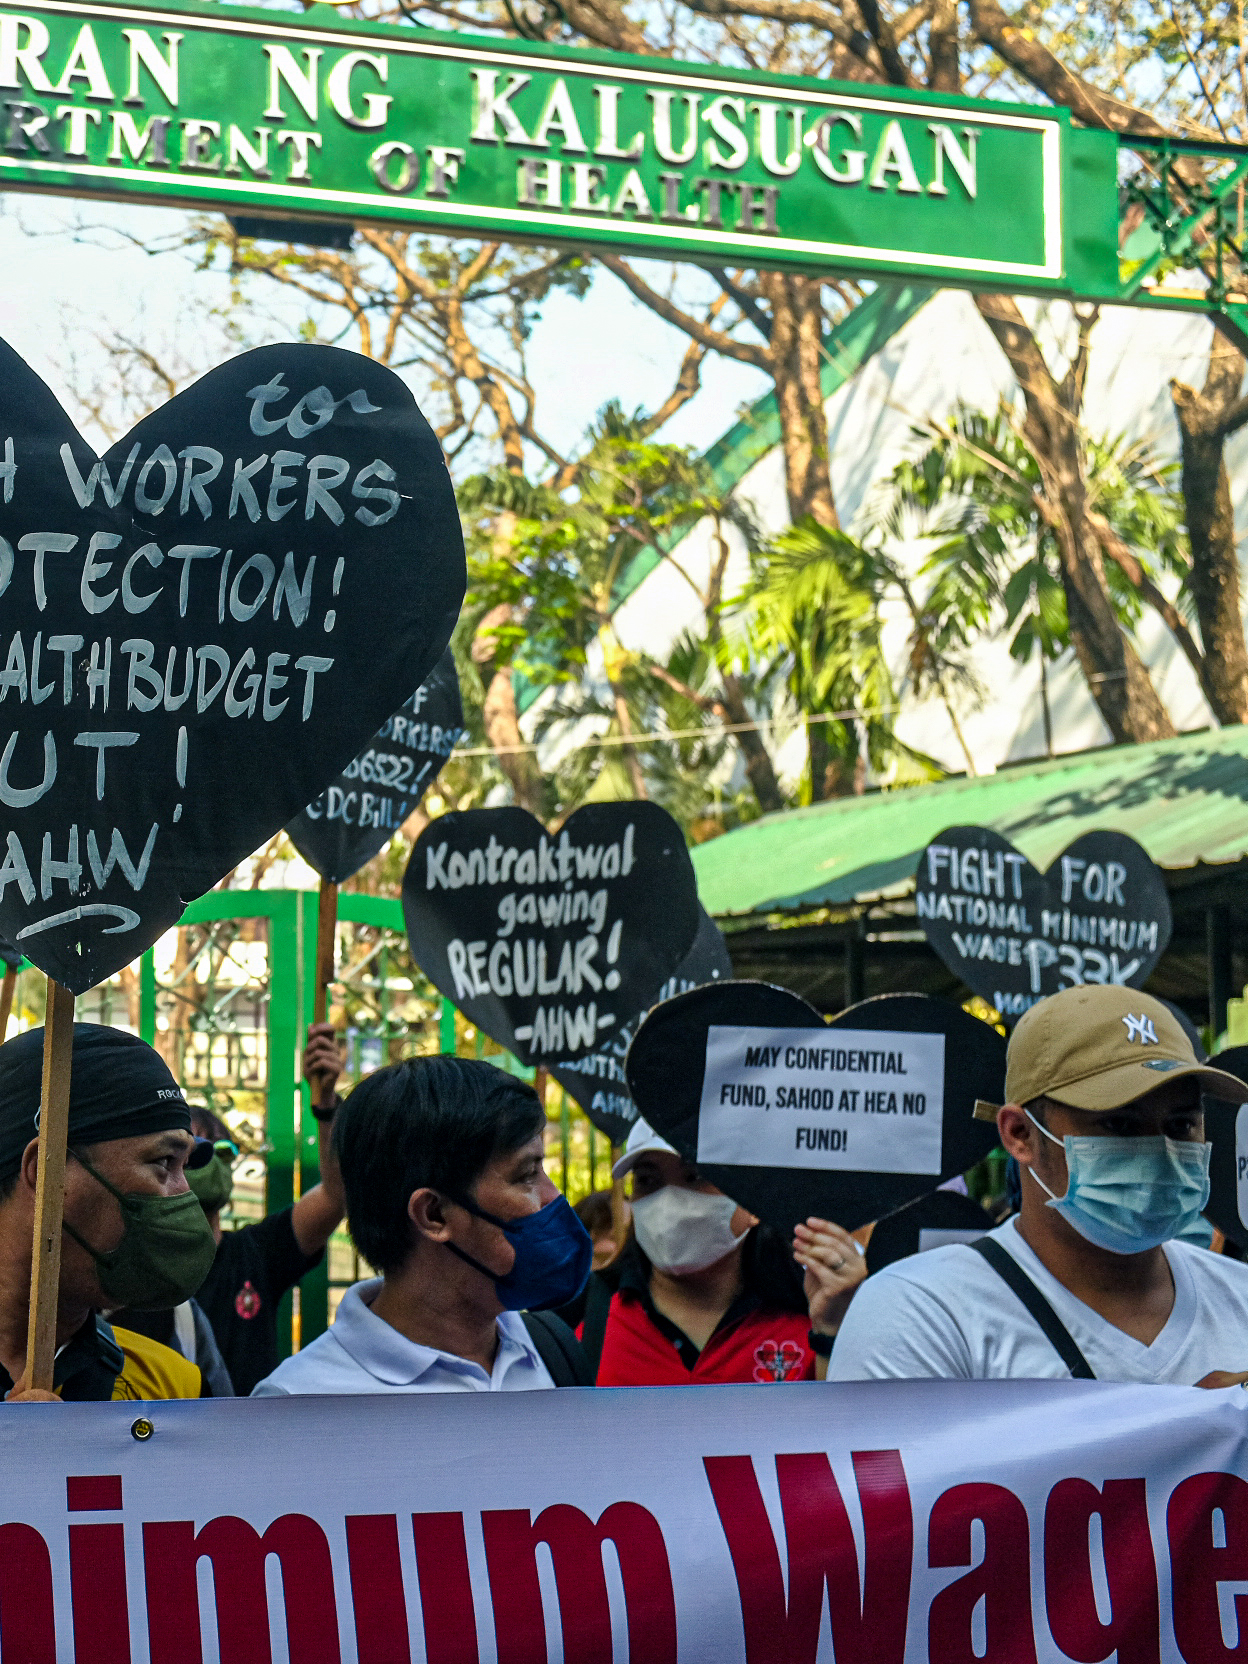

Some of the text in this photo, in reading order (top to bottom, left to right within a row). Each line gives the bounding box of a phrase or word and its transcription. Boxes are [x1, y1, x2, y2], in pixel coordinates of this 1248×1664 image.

[262, 43, 393, 132] NG
[469, 67, 981, 199] KALUSUGAN
[371, 141, 466, 197] OF
[517, 158, 780, 234] HEALTH
[59, 442, 403, 527] WORKERS
[120, 637, 335, 722] BUDGET
[426, 823, 635, 890] Kontraktwal
[927, 845, 1126, 907] FIGHT FOR
[498, 884, 608, 937] gawing
[916, 892, 1158, 952] NATIONAL MINIMUM
[448, 919, 622, 999] REGULAR!
[952, 932, 1022, 967] WAGE
[1122, 1012, 1159, 1045] NY
[744, 1046, 908, 1075] MAY CONFIDENTIAL
[720, 1084, 927, 1116] FUND, SAHOD AT HEA NO
[796, 1127, 848, 1153] FUND!
[701, 1448, 1248, 1664] Wage
